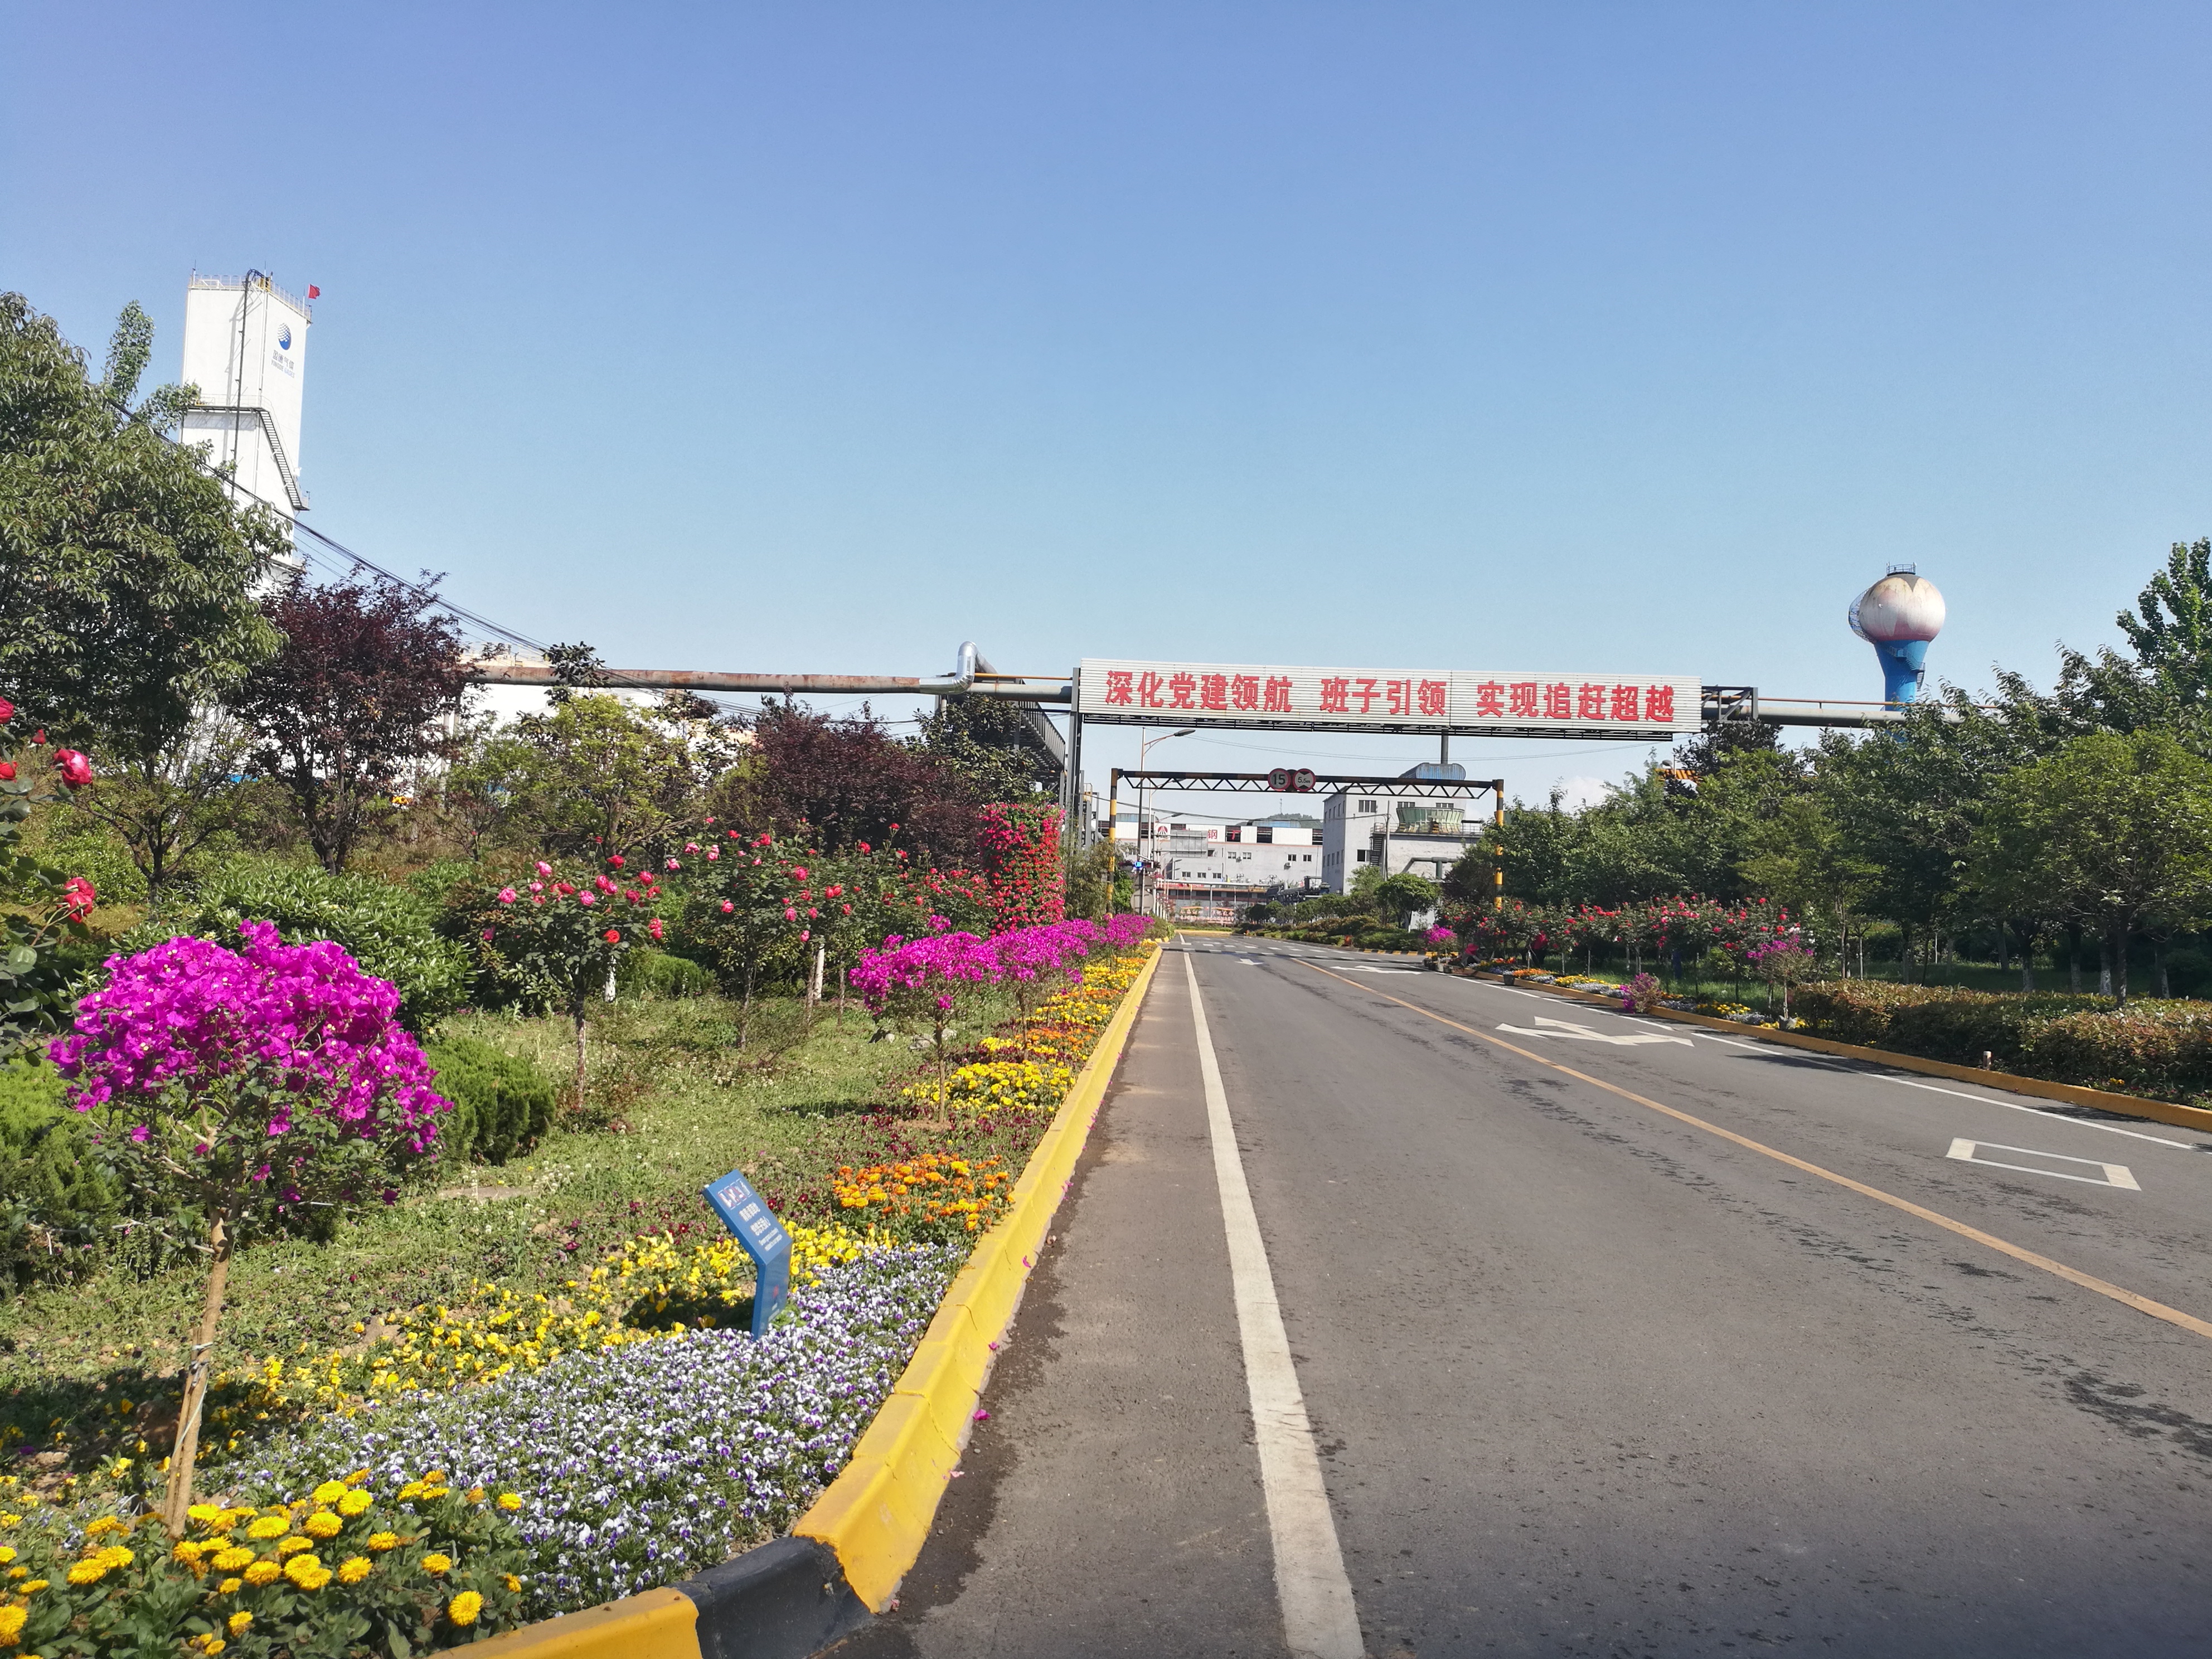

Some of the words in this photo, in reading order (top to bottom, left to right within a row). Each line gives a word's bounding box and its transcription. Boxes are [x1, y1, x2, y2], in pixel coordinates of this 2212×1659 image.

[1104, 671, 1293, 712] 深化党建领航
[1319, 677, 1447, 716] 班子引领
[1476, 681, 1675, 722] 实现追赶超越
[1273, 774, 1286, 785] 15
